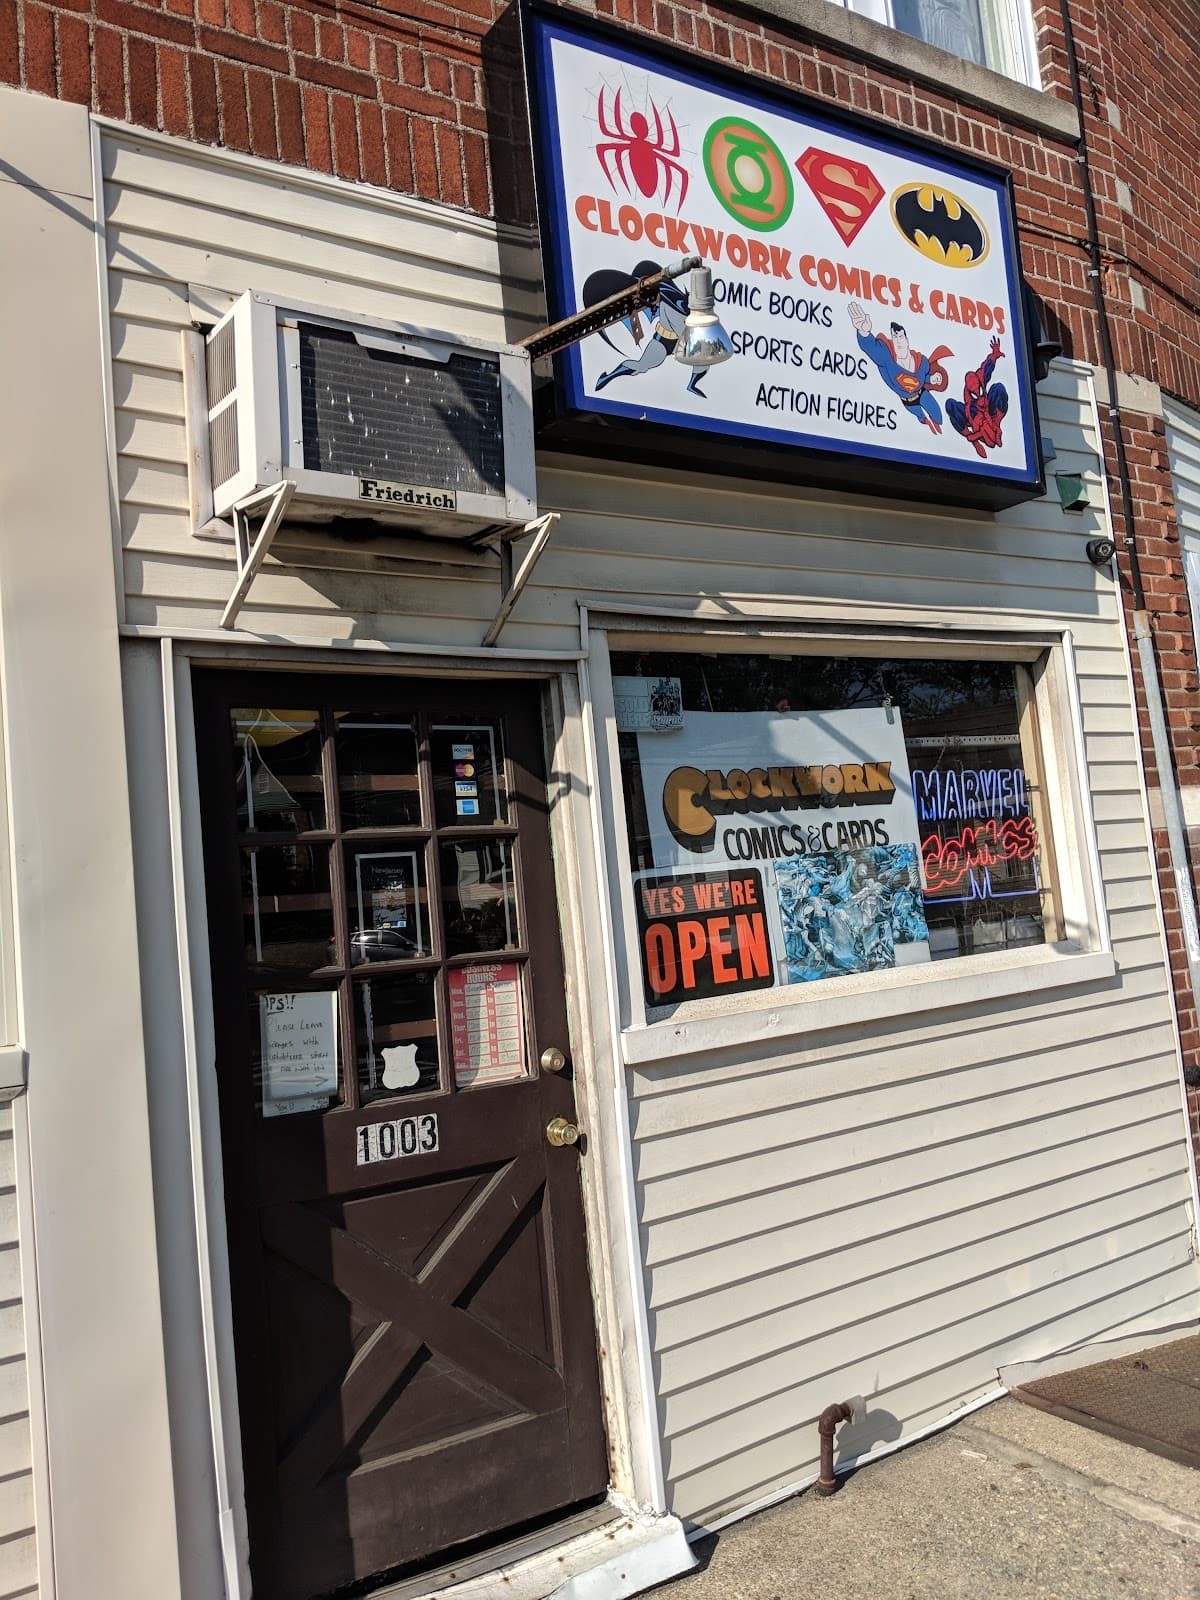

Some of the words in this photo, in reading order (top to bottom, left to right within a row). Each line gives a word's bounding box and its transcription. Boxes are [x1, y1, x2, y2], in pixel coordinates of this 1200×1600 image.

[574, 195, 793, 281] CLOCKWORK
[799, 254, 902, 308] COMICS
[908, 283, 925, 314] &
[929, 289, 1006, 335] CARDS
[712, 278, 762, 312] OMIC
[768, 291, 833, 328] BOOKS
[730, 330, 803, 367] SPORTS
[809, 346, 868, 381] CARDS
[755, 383, 821, 417] ACTION
[827, 396, 897, 430] FIGURES
[360, 479, 455, 508] Friedrich
[662, 761, 897, 854] CLOCKWORK
[912, 768, 1032, 821] MARVEL
[722, 823, 806, 861] COMICS
[821, 818, 890, 853] CARDS
[642, 886, 686, 916] YES
[692, 879, 757, 910] WE'RE
[644, 912, 770, 994] OPEN
[359, 1115, 437, 1162] 1003
